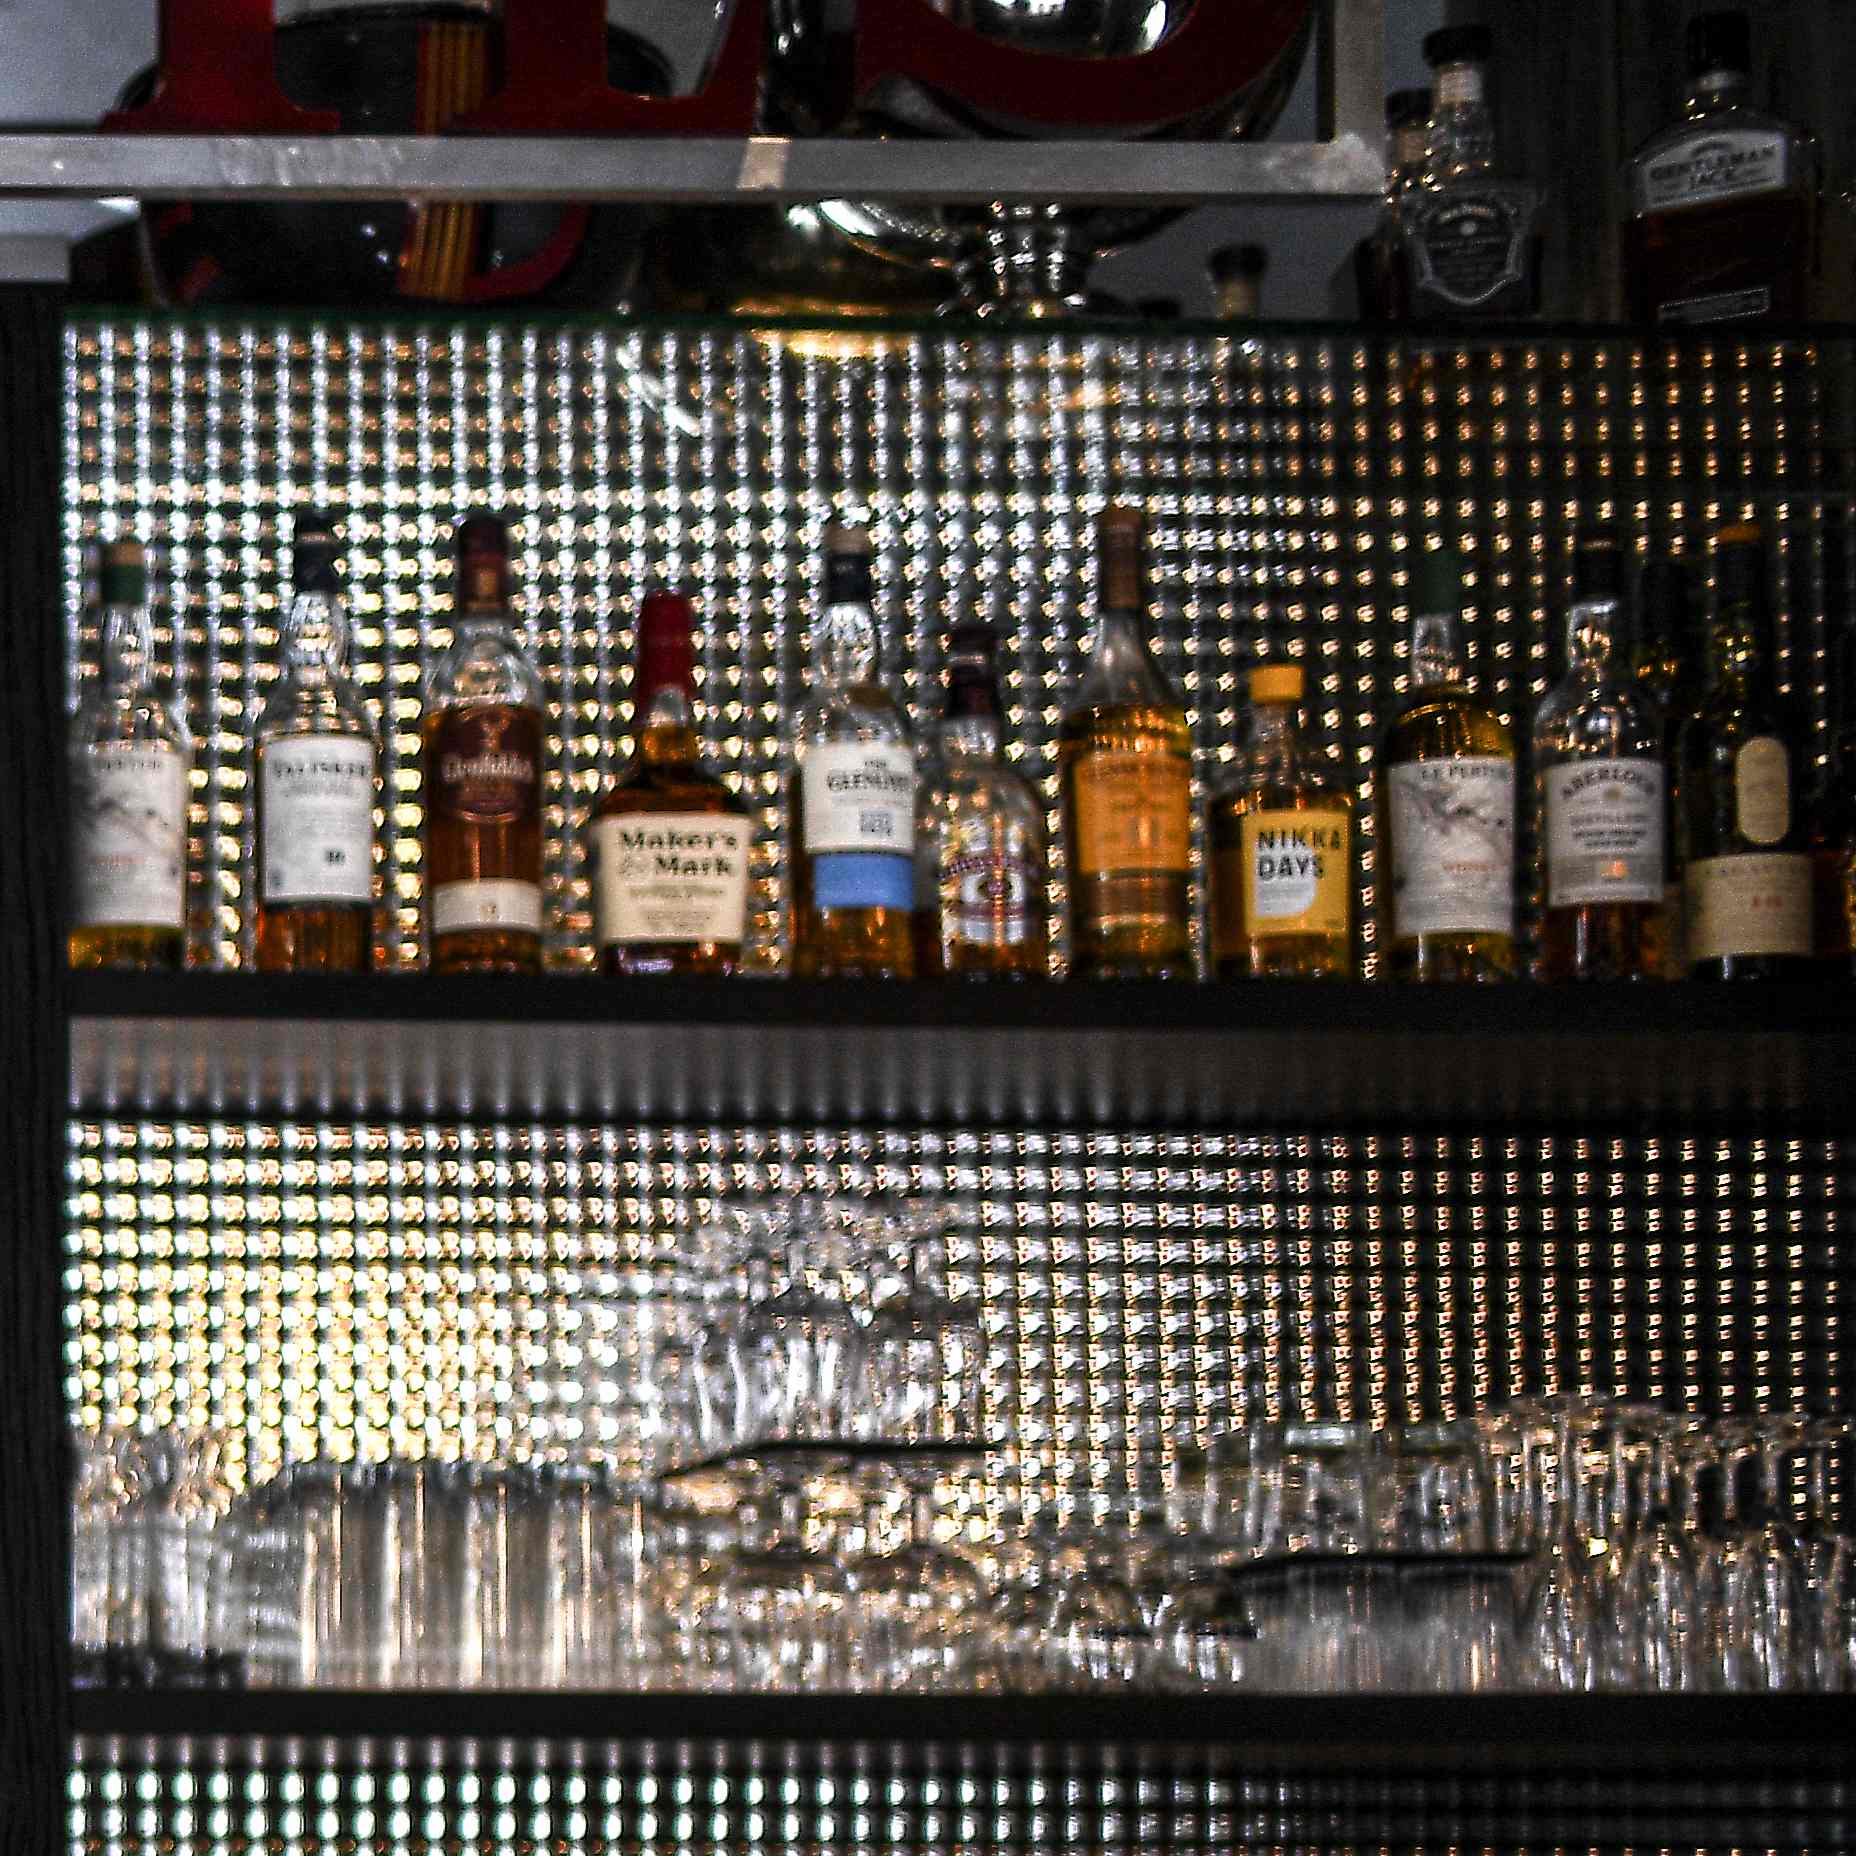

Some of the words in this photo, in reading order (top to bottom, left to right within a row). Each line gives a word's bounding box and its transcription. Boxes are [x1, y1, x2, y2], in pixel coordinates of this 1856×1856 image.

[620, 830, 738, 851] Maker's
[1258, 831, 1340, 849] NIKKA
[655, 855, 730, 876] Mark
[1258, 855, 1324, 880] DAYS
